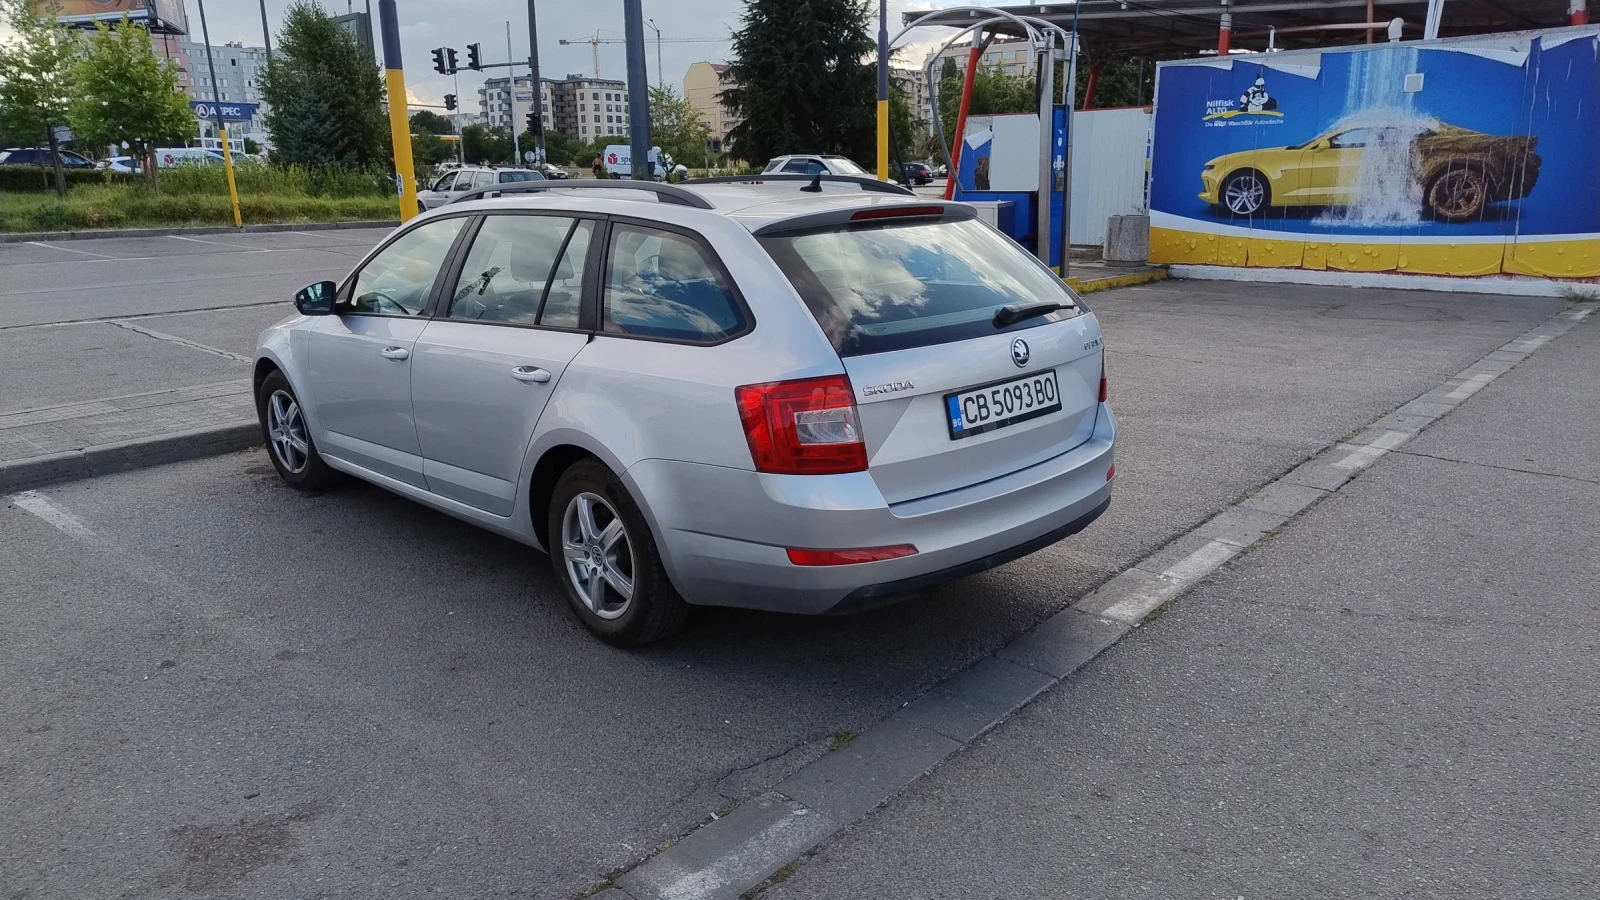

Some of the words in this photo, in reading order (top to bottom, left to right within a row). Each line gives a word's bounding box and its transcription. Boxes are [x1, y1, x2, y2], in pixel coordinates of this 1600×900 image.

[1206, 107, 1227, 115] ALTO
[963, 394, 991, 424] CB
[991, 382, 1033, 416] 5093
[1034, 377, 1055, 405] BO
[953, 418, 962, 427] BG
